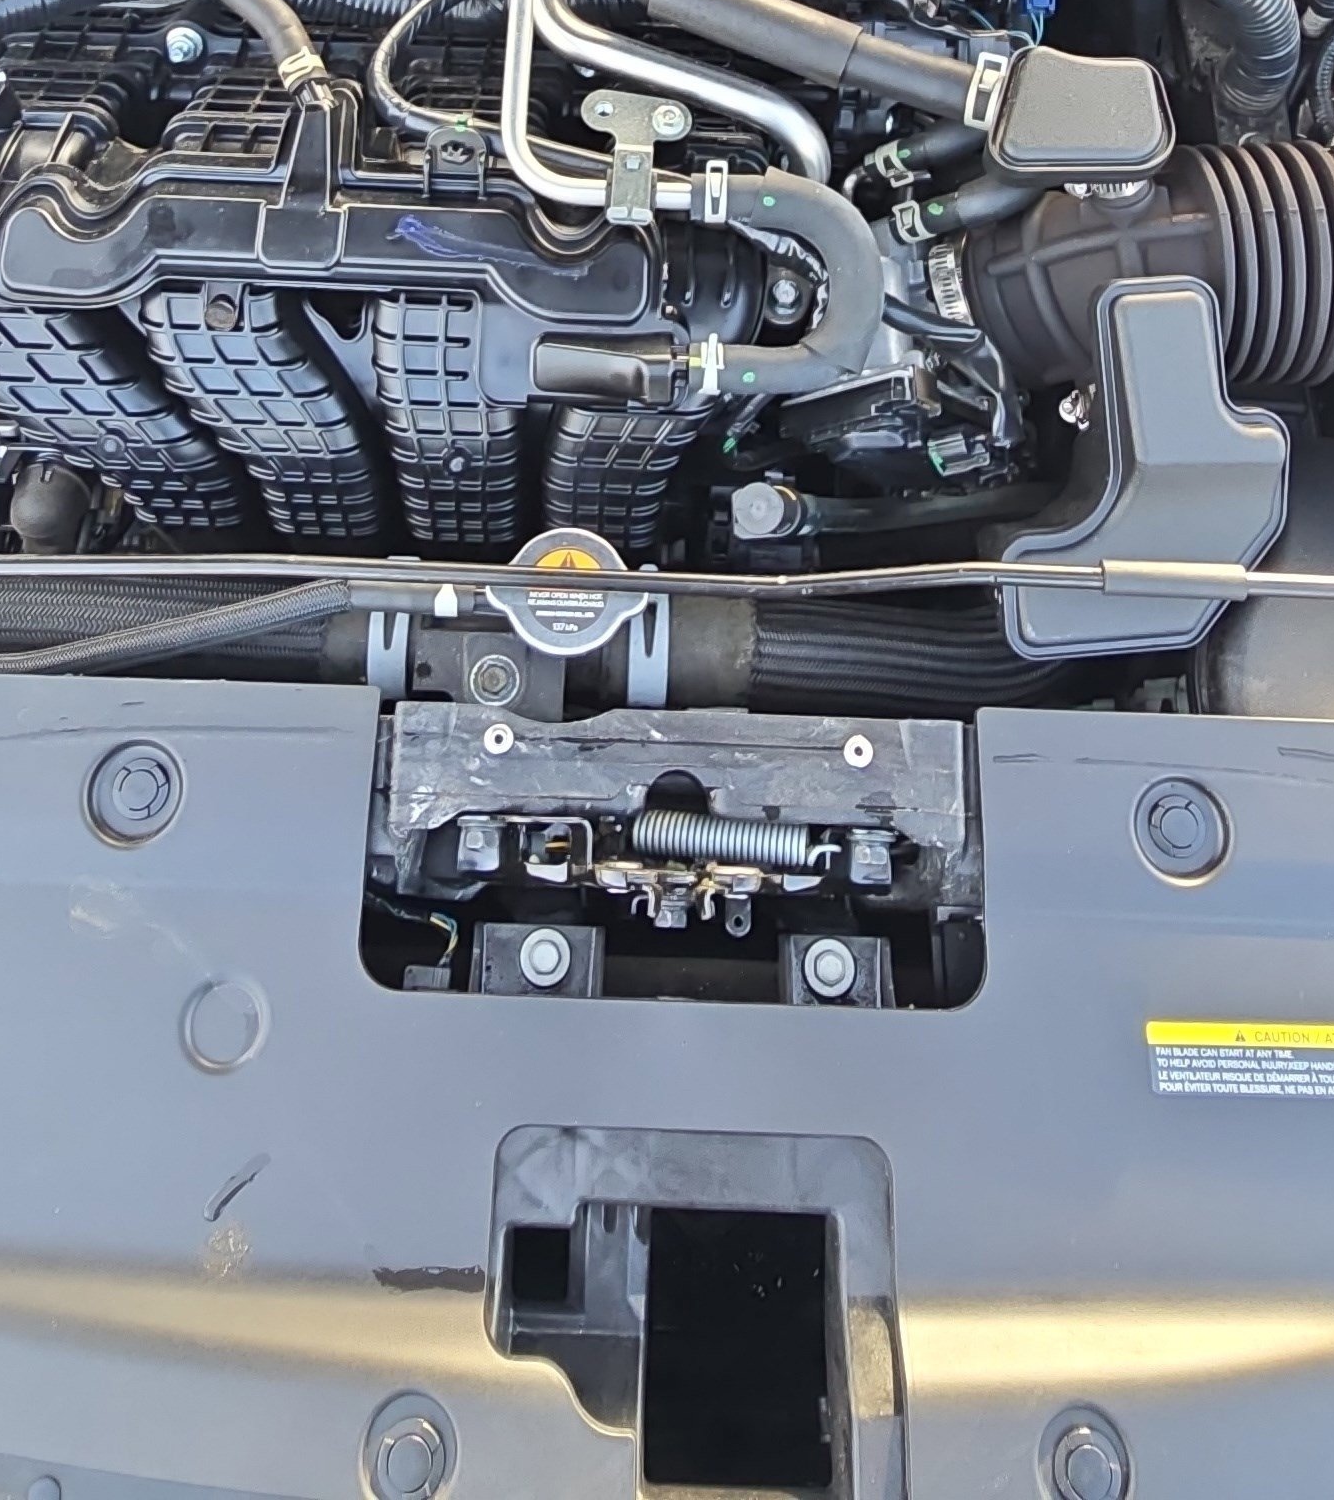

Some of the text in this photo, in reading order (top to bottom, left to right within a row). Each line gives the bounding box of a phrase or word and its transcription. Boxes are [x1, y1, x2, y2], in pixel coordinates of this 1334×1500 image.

[1255, 1032, 1310, 1043] CAUTION
[1173, 1048, 1199, 1056] BLADE
[1201, 1048, 1218, 1057] CAN
[1219, 1049, 1243, 1057] START
[1245, 1049, 1255, 1058] AT
[1256, 1049, 1272, 1058] ANY
[1157, 1059, 1168, 1068] TO
[1169, 1059, 1190, 1068] HELP
[1192, 1060, 1216, 1069] AVOID
[1218, 1060, 1261, 1070] PERSONAL
[1158, 1071, 1168, 1080] LE
[1170, 1072, 1221, 1081] VENTILATEUR
[1223, 1072, 1252, 1082] RISQUE
[1254, 1073, 1264, 1082] DE
[1159, 1083, 1184, 1092] POUR
[1185, 1081, 1211, 1092] ÉVITER
[1213, 1084, 1238, 1093] TOUTE
[1285, 1085, 1296, 1094] NE
[1298, 1086, 1314, 1095] PAS
[1315, 1086, 1326, 1095] EN
